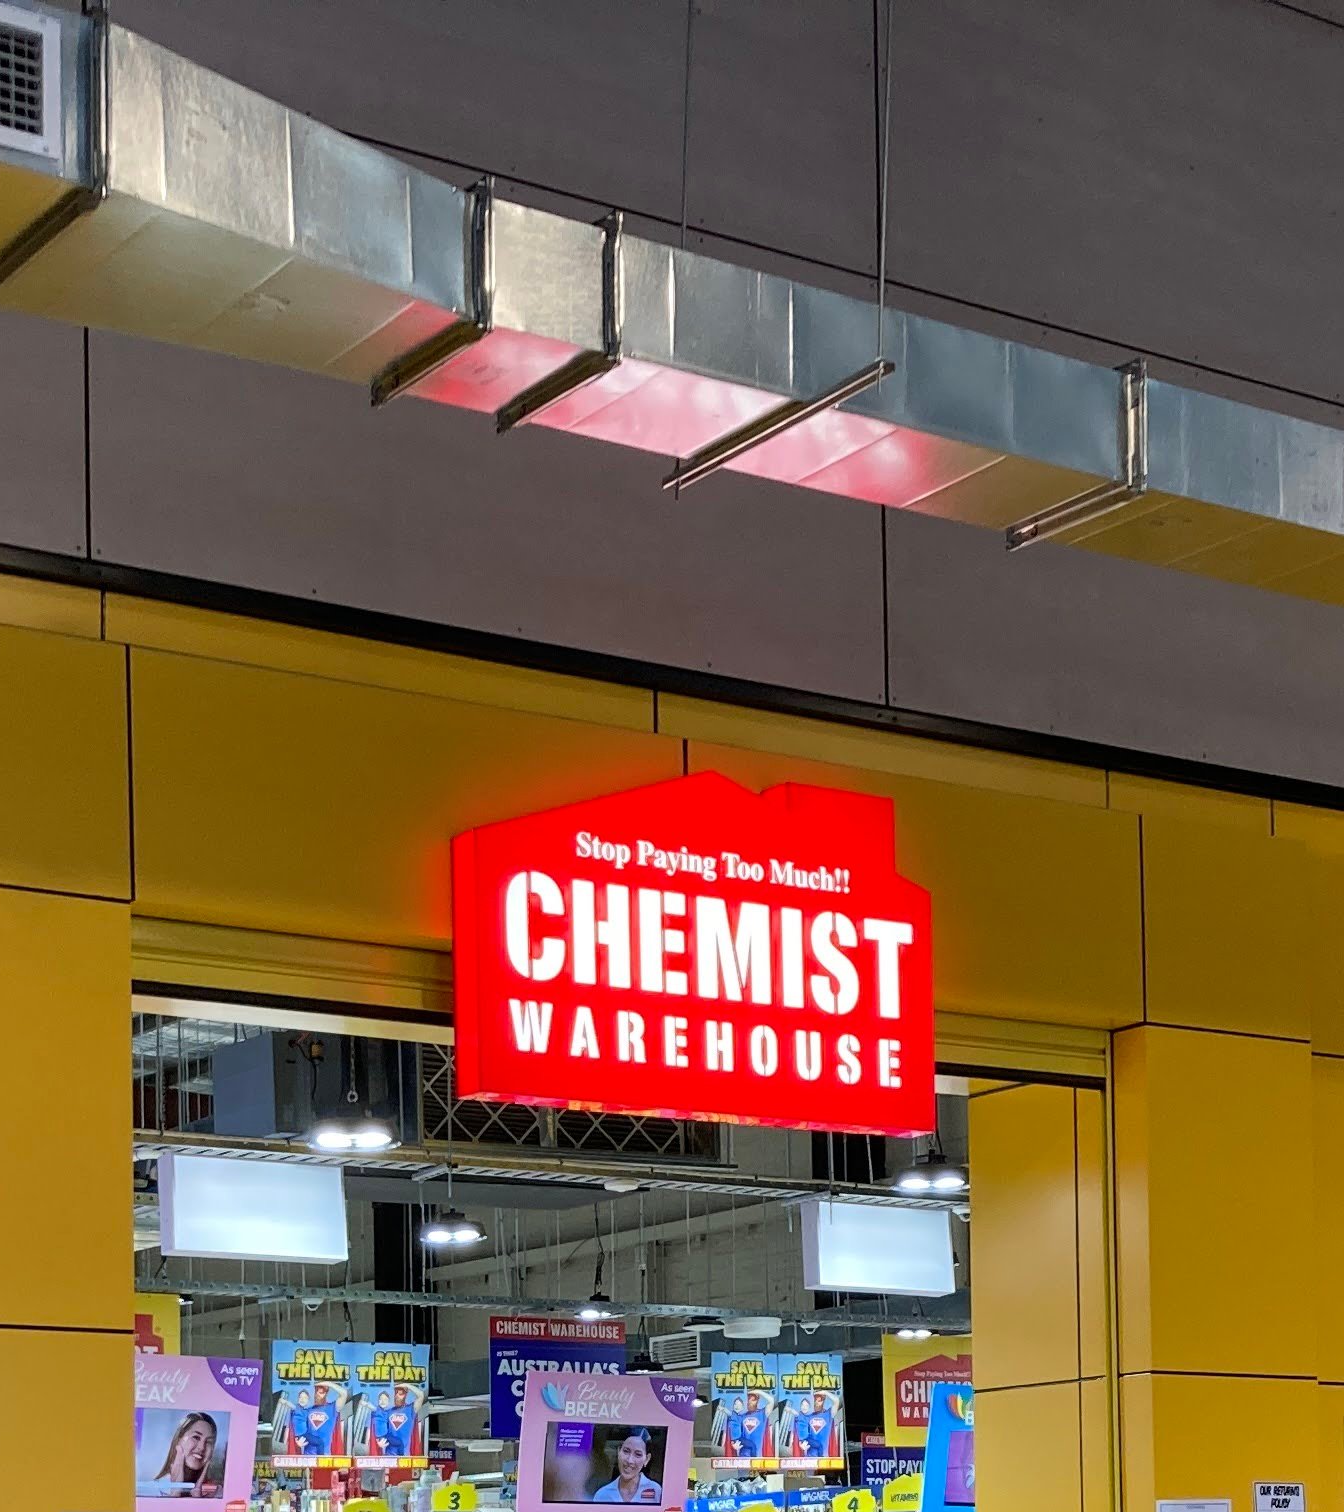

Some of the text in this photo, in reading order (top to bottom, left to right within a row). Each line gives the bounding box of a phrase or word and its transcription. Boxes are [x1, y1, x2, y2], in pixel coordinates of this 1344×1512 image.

[575, 830, 851, 895] Stop Paying Too Much!!
[505, 870, 914, 1020] CHEMIST
[508, 999, 902, 1089] WAREHOUSE
[496, 1320, 619, 1339] CHEMIST WAREHOUSE
[295, 1349, 334, 1364] SAVE
[374, 1351, 412, 1366] SAVE
[220, 1364, 259, 1376] As seen
[277, 1364, 350, 1380] THE DAY!
[356, 1366, 426, 1381] THE DAY!
[730, 1361, 763, 1374] SAVE
[797, 1362, 828, 1376] SAVE
[224, 1376, 254, 1386] on TV
[660, 1383, 694, 1394] As seen
[715, 1374, 775, 1388] THE DAY!
[782, 1375, 840, 1390] THE DAY!
[135, 1386, 175, 1403] EAK
[578, 1380, 635, 1409] Beauty
[663, 1394, 690, 1403] on TV
[564, 1401, 622, 1418] BREAK
[866, 1459, 924, 1474] STOP PAYI
[801, 1491, 830, 1502] WAGNER
[1259, 1485, 1300, 1496] OUR RETURNS
[447, 1492, 460, 1510] 3
[708, 1499, 737, 1510] WAGNER
[1270, 1498, 1291, 1509] POLICY
